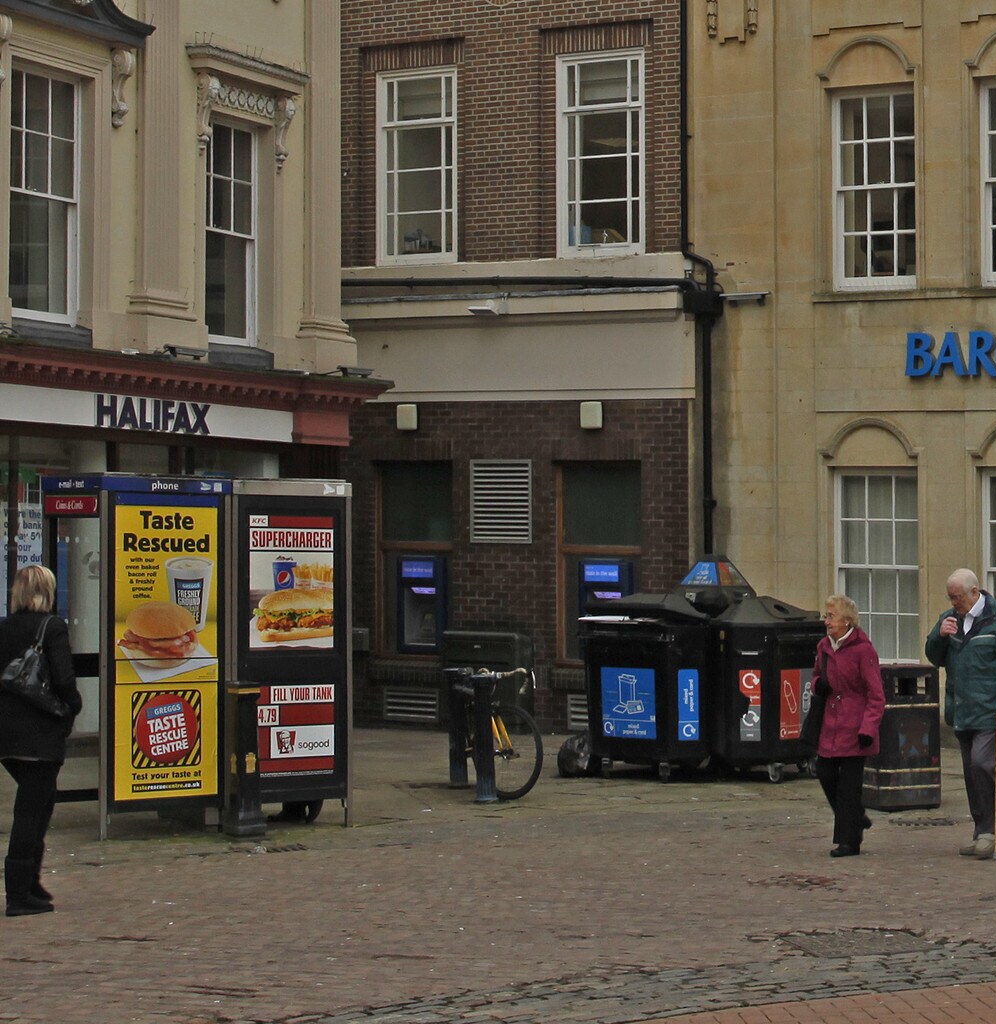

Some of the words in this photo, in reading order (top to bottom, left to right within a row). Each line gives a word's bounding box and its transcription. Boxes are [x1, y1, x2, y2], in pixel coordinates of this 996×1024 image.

[96, 394, 211, 434] HALIFAX
[151, 480, 179, 491] phone
[140, 510, 194, 530] Taste
[123, 532, 210, 553] Rescued
[252, 530, 332, 548] SUPERCHARGER
[273, 687, 288, 701] FILL
[290, 687, 310, 700] YOUR
[312, 686, 333, 700] TANK
[154, 703, 182, 715] GREGGS
[147, 713, 186, 733] TASTE
[148, 727, 188, 745] RESCUE
[298, 739, 330, 750] sogood
[150, 738, 189, 756] CENTRE
[132, 772, 148, 781] Test
[150, 772, 169, 781] your
[172, 770, 191, 778] taste
[193, 769, 201, 777] at
